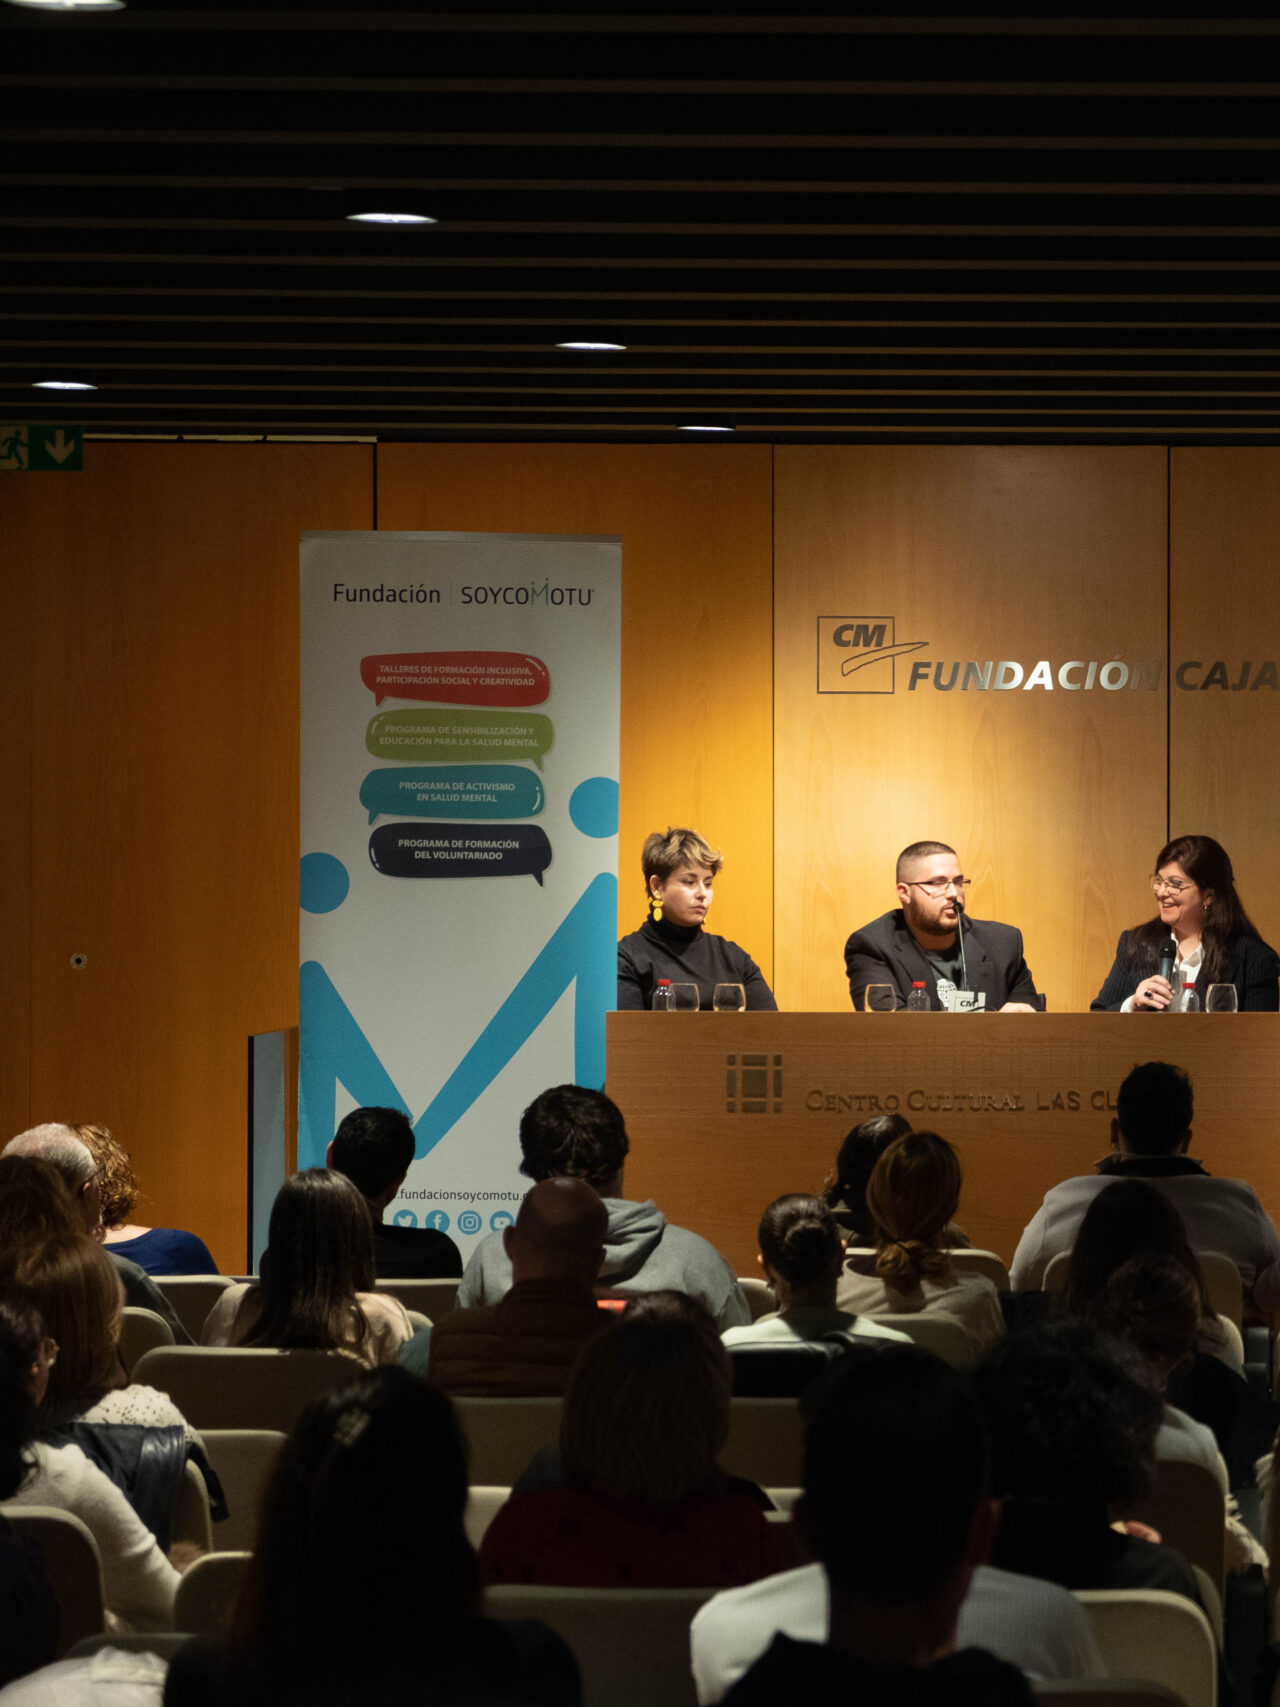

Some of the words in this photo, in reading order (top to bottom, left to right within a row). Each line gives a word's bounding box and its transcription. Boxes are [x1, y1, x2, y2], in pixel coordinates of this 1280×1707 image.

[333, 583, 441, 603] Fundación
[461, 578, 592, 606] SOYCOMOTU
[832, 623, 887, 648] CM
[379, 665, 420, 674] TALLERES
[421, 666, 433, 674] DE
[434, 665, 485, 675] FORMACIÓN
[486, 666, 533, 676] INCLUSIVA,
[907, 654, 1163, 692] FUNDACIÓN
[376, 675, 439, 685] PARTICIPACIÓN
[440, 676, 471, 685] SOCIAL
[472, 677, 478, 685] Y
[479, 677, 535, 687] CREATIVIDAD
[385, 725, 436, 735] PROGRAMA
[438, 726, 450, 735] DE
[451, 725, 527, 736] SENSIBILIZACIÓN
[528, 727, 535, 736] Y
[379, 735, 432, 745] EDUCACIÓN
[433, 736, 456, 746] PARA
[459, 737, 470, 746] LA
[472, 737, 502, 746] SALUD
[503, 738, 540, 747] MENTAL
[399, 781, 450, 791] PROGRAMA
[452, 782, 464, 791] DE
[466, 782, 515, 791] ACTIVISMO
[416, 793, 429, 802] EN
[430, 793, 460, 802] SALUD
[461, 794, 498, 803] MENTAL
[398, 839, 450, 848] PROGRAMA
[451, 840, 464, 848] DE
[465, 838, 520, 849] FORMACIÓN
[414, 851, 432, 859] DEL
[433, 851, 503, 860] VOLUNTARIADO
[1036, 1090, 1081, 1111] LAS
